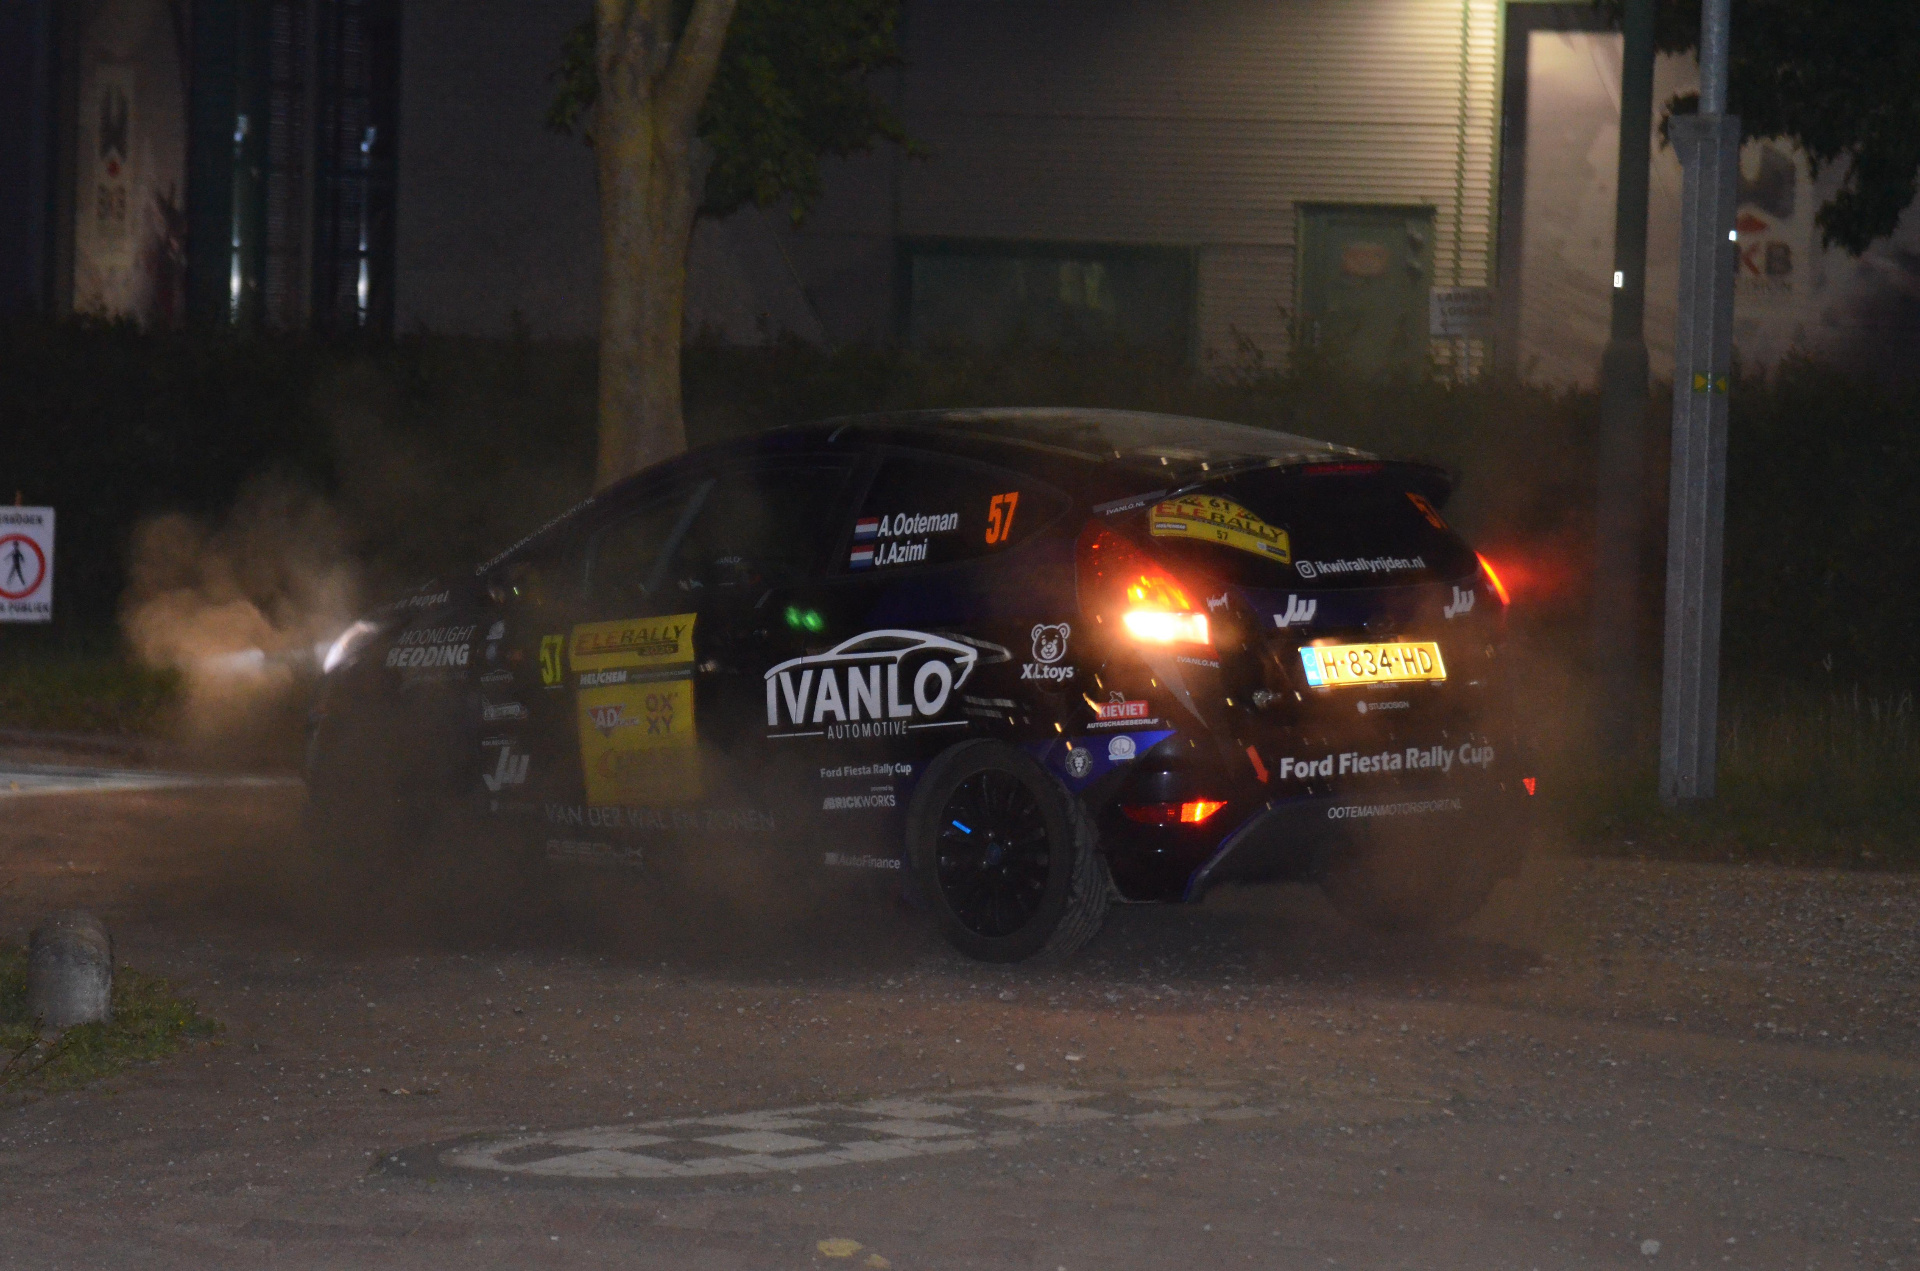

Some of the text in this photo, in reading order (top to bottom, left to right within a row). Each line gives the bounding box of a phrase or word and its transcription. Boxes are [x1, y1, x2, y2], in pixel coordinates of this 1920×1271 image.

[985, 491, 1019, 545] 57
[1105, 501, 1147, 516] IVANLO.NL
[877, 512, 959, 538] A.Ooteman
[1155, 502, 1284, 543] ELERALLY
[1216, 530, 1229, 541] 57
[874, 538, 929, 566] J.Azimi
[1316, 556, 1427, 577] ikwilrallyrijden.nl
[397, 624, 477, 646] MOONLIGHT
[576, 625, 687, 651] ELERALLY
[386, 644, 470, 667] BEDDING
[540, 634, 565, 686] 57
[765, 659, 953, 727] IVANLO
[1098, 703, 1146, 719] KIEVIET
[827, 720, 908, 740] AUTOMOTIVE
[1086, 718, 1160, 730] AUTOSCHADEBEDRIJF
[820, 762, 913, 778] Ford Fiesta Rally Cup
[1279, 743, 1495, 780] Ford Fiesta Rally Cup
[545, 804, 585, 827] VAN
[588, 806, 622, 829] DER
[1326, 798, 1463, 820] OOTEMANMOTORSPORT.NL
